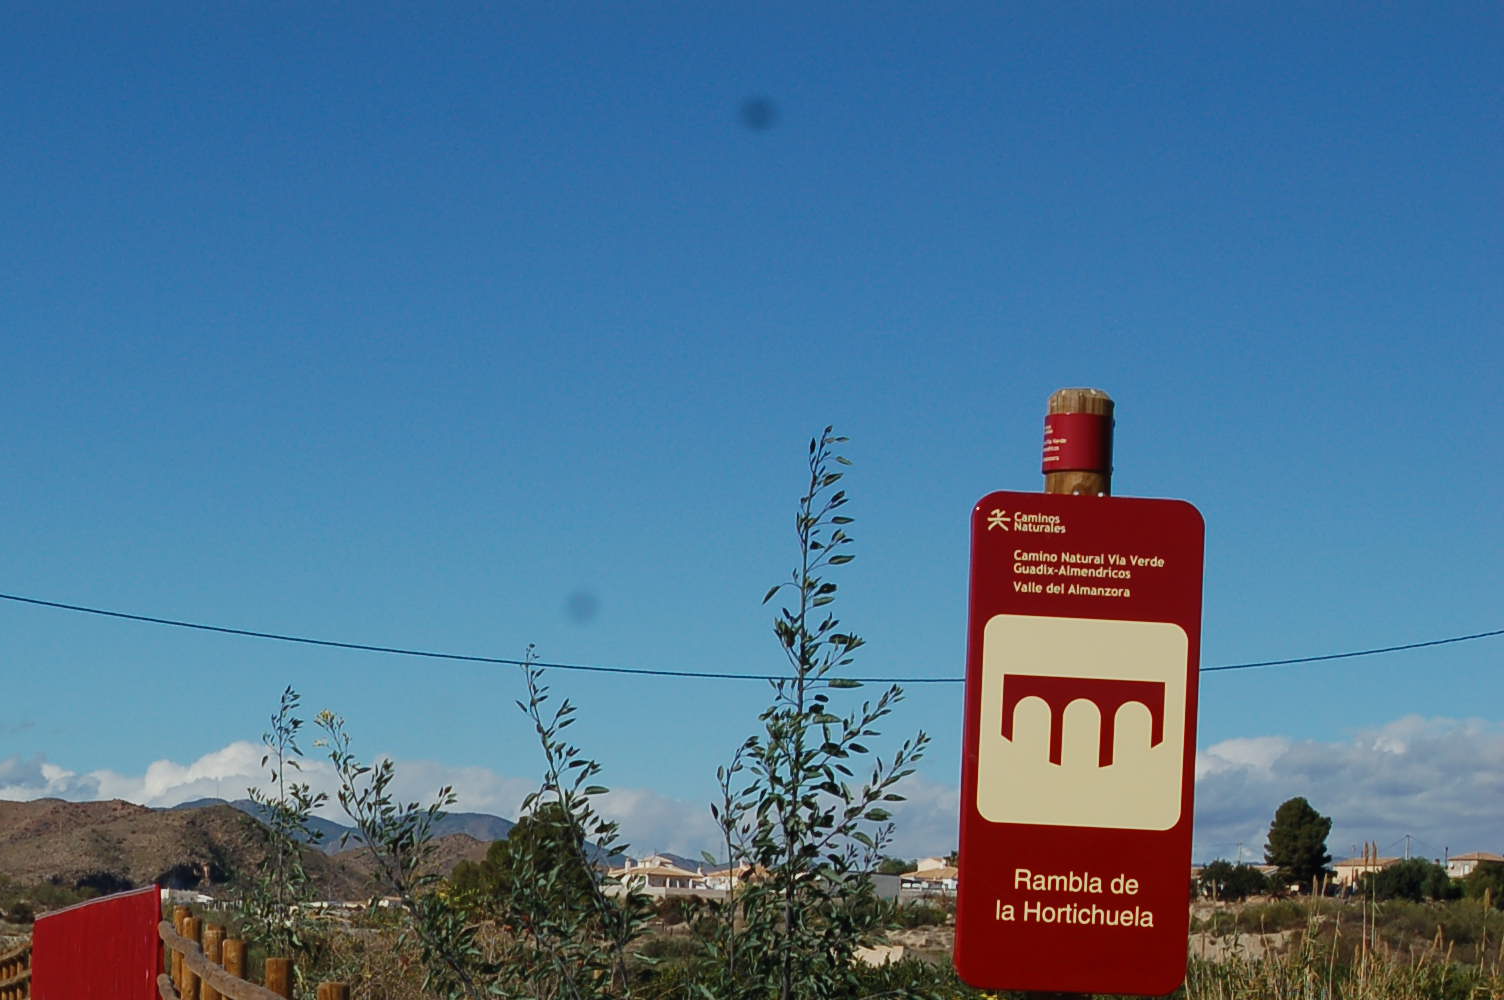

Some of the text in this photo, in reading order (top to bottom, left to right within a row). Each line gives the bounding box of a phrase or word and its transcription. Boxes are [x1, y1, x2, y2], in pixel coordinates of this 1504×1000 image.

[1014, 512, 1060, 523] Caminos
[1014, 521, 1066, 533] Naturales
[1013, 550, 1057, 562] Camino
[1061, 552, 1104, 564] Natural
[1130, 555, 1165, 567] Verde
[1013, 563, 1131, 578] Guadix-Almendricos
[1013, 581, 1130, 597] Valle del Almanzora
[1014, 868, 1139, 896] Rambla de
[995, 900, 1154, 928] la Hortichuela
